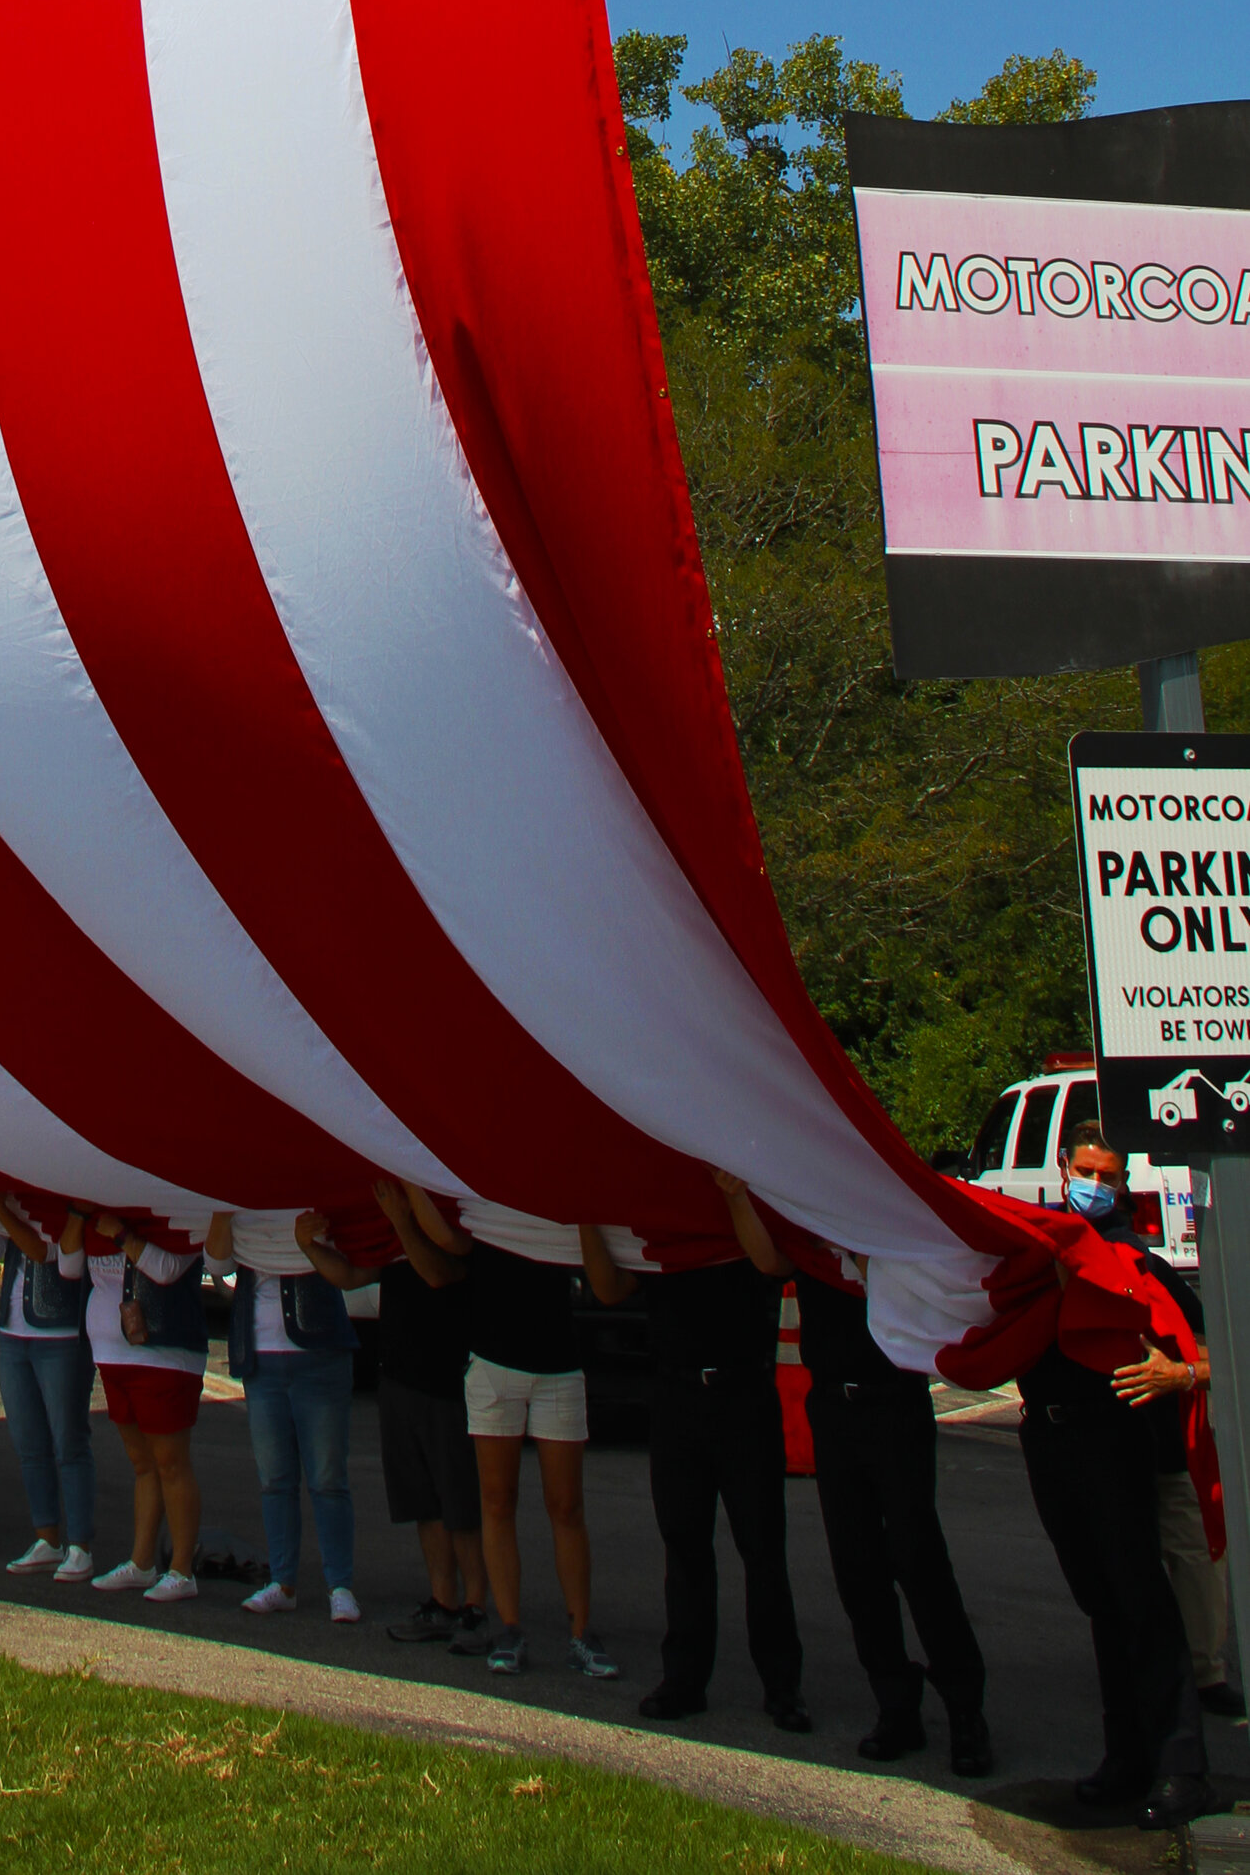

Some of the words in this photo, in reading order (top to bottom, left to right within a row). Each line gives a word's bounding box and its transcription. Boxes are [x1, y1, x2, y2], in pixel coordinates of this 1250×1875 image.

[1089, 794, 1250, 822] MOTORCO
[1122, 986, 1250, 1007] VIOLATORS
[1161, 1020, 1186, 1041] BE
[1193, 1019, 1250, 1041] TOW
